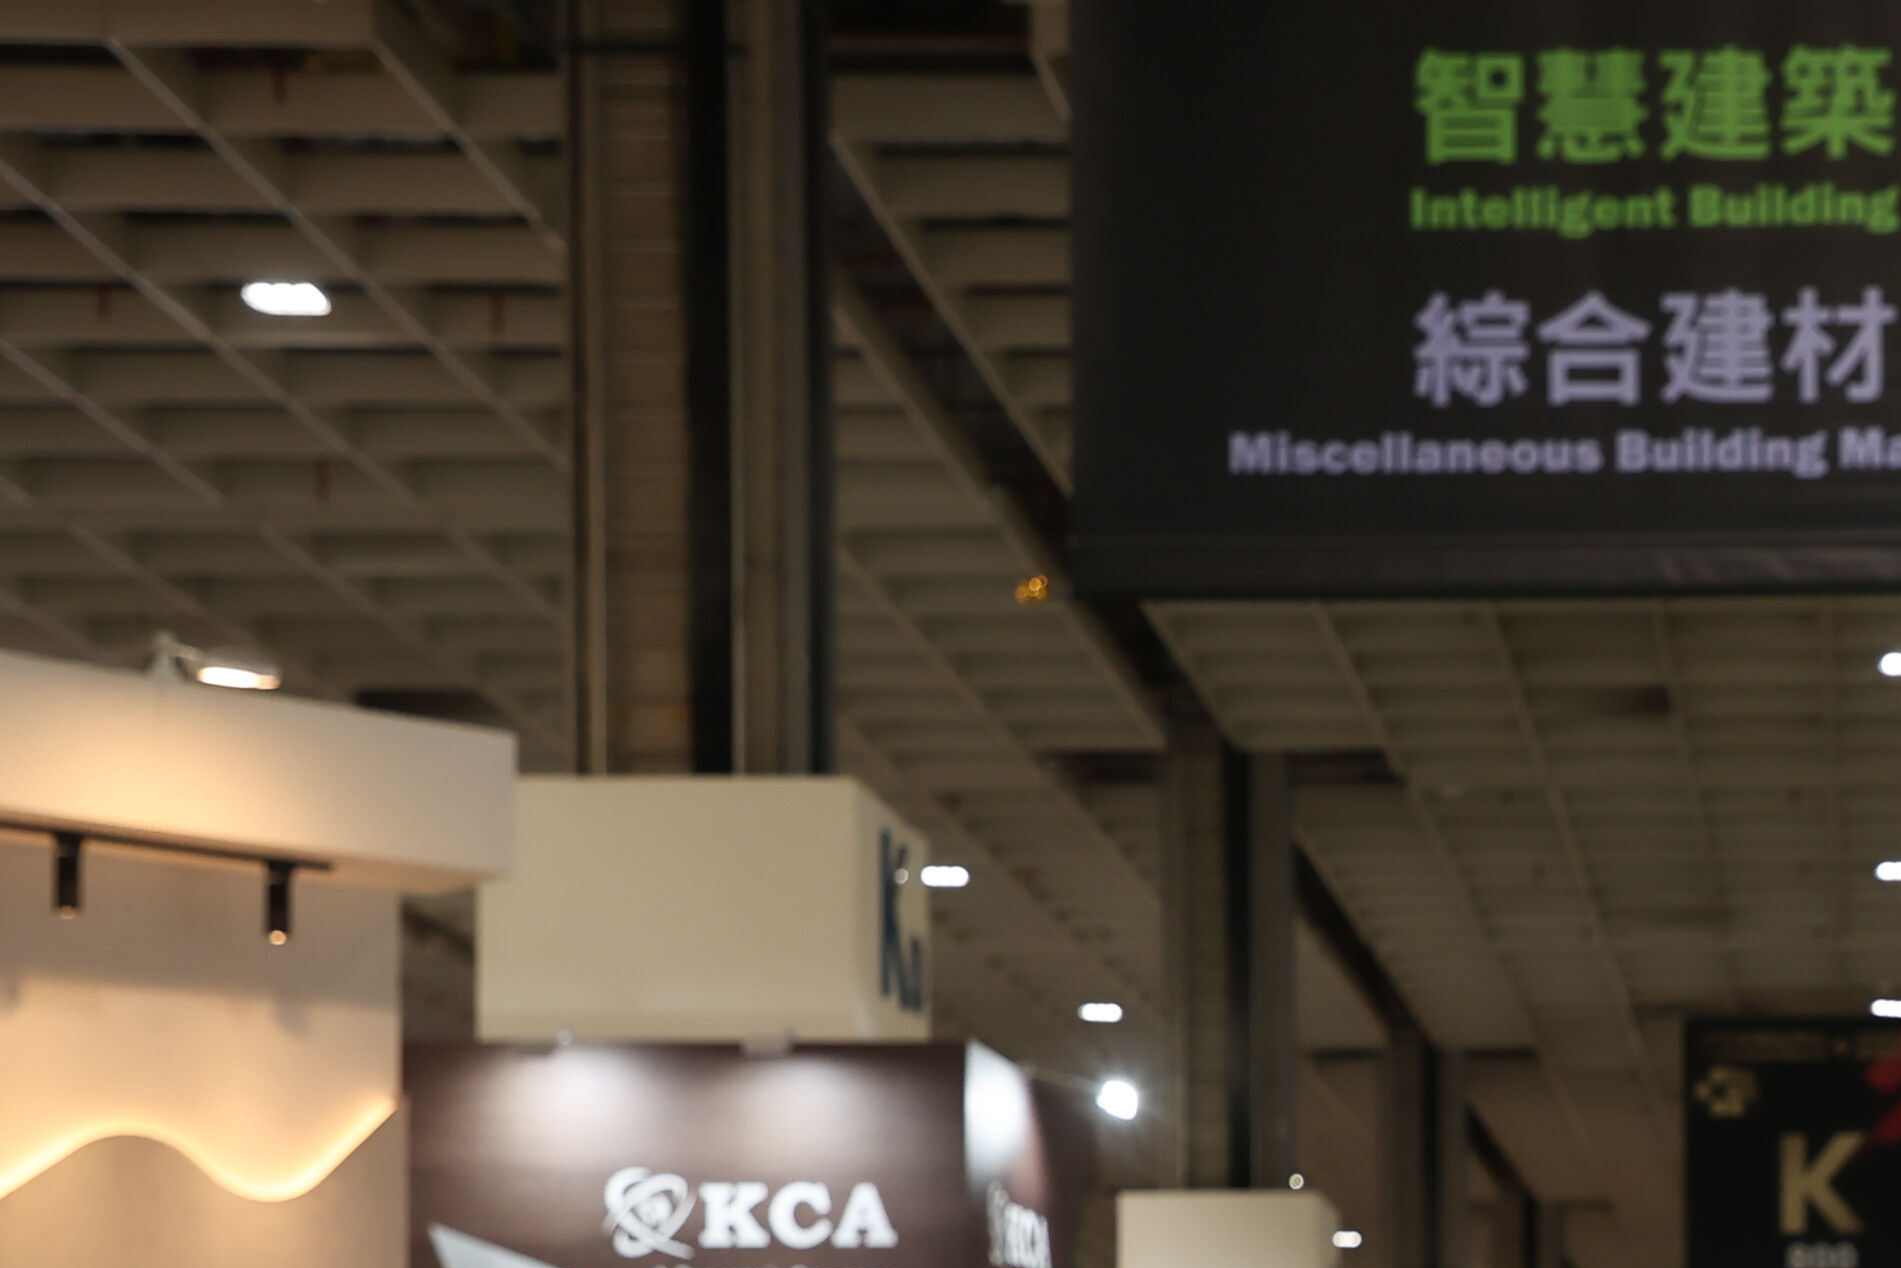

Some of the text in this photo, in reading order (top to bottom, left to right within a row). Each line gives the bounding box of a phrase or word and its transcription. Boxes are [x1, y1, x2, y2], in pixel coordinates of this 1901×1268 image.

[1413, 46, 1898, 165] 智慧建築
[1410, 182, 1901, 237] Intelligent Building
[1413, 287, 1898, 407] 綜合建材
[1228, 430, 1602, 474] Miscellaneous
[1614, 428, 1829, 478] Building
[698, 1180, 899, 1250] KCA
[1780, 1132, 1864, 1236] K
